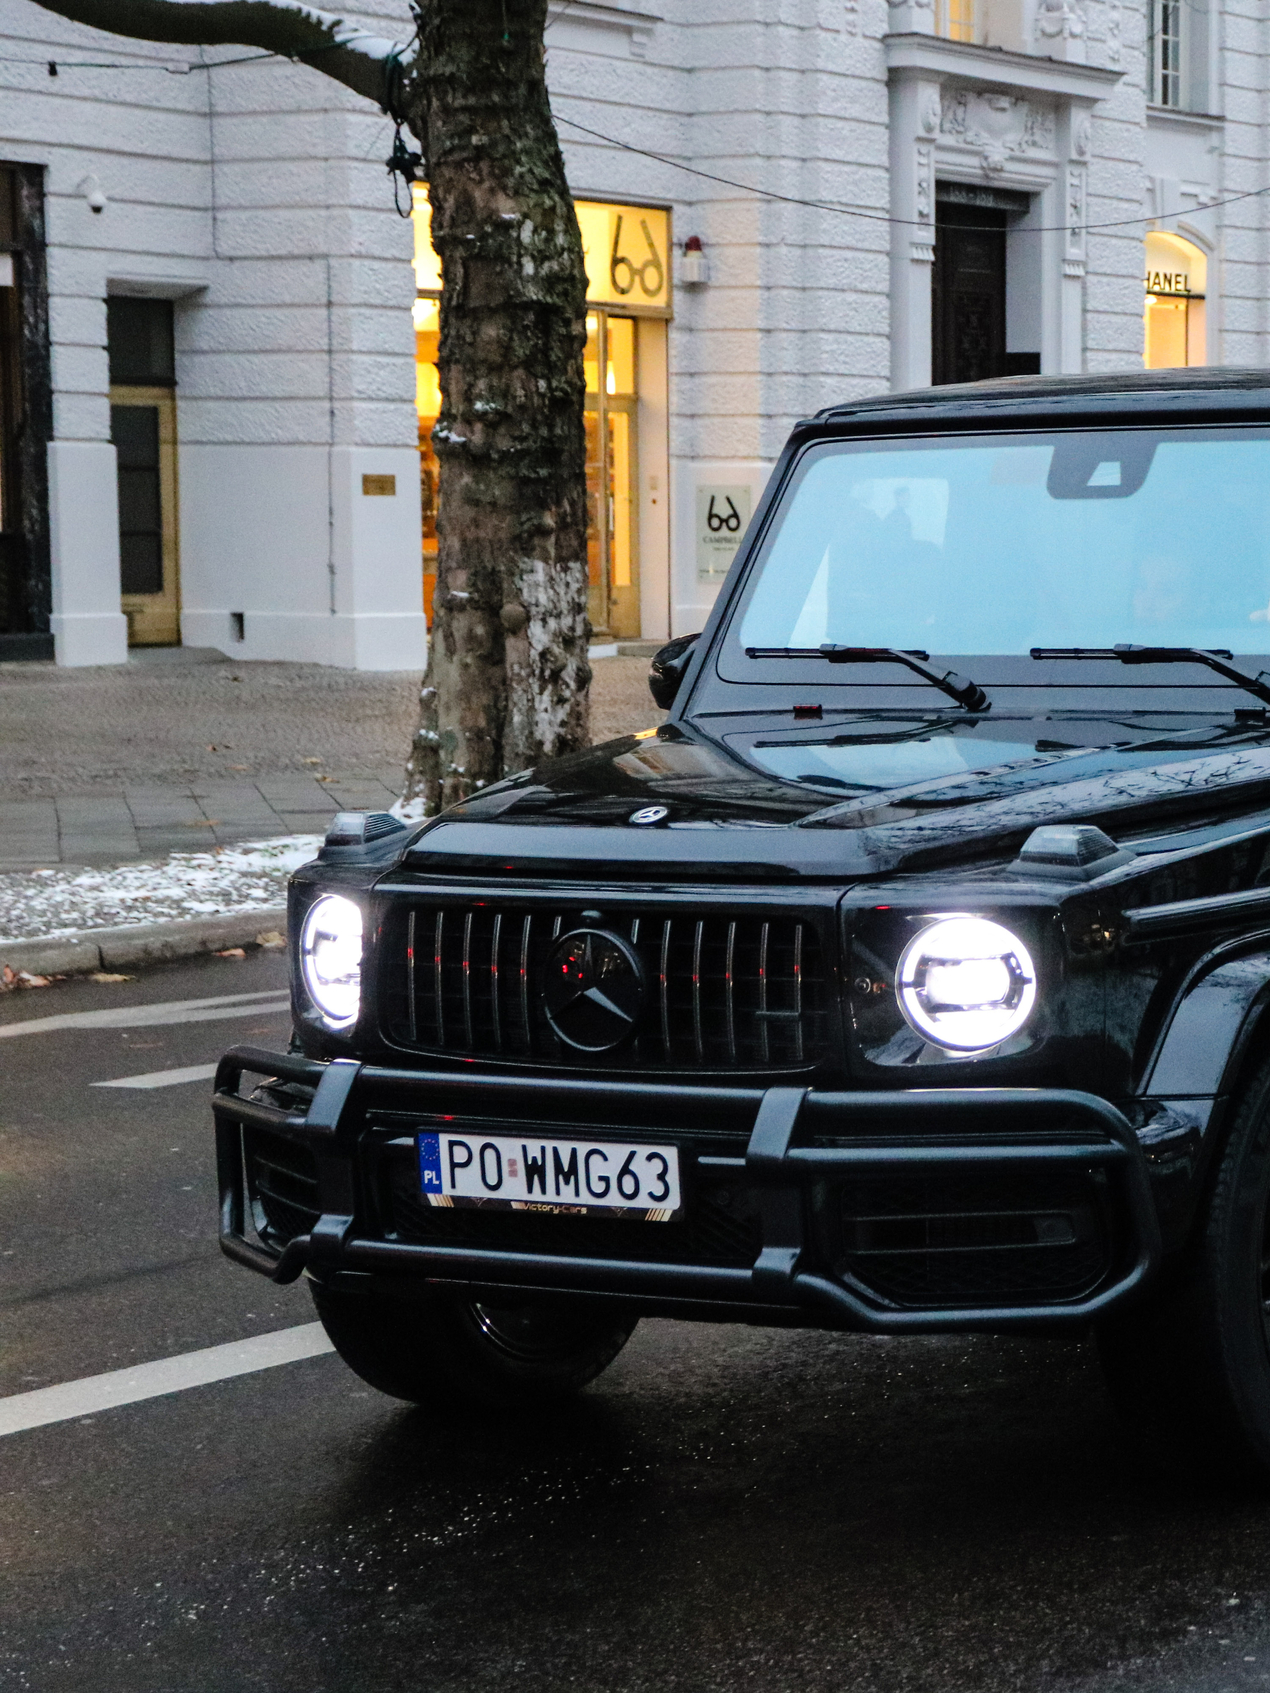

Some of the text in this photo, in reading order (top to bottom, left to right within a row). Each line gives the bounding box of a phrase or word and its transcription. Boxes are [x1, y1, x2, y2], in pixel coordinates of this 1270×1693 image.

[1144, 270, 1192, 293] HANEL
[423, 1169, 440, 1185] PL
[448, 1139, 671, 1203] PO WMG63
